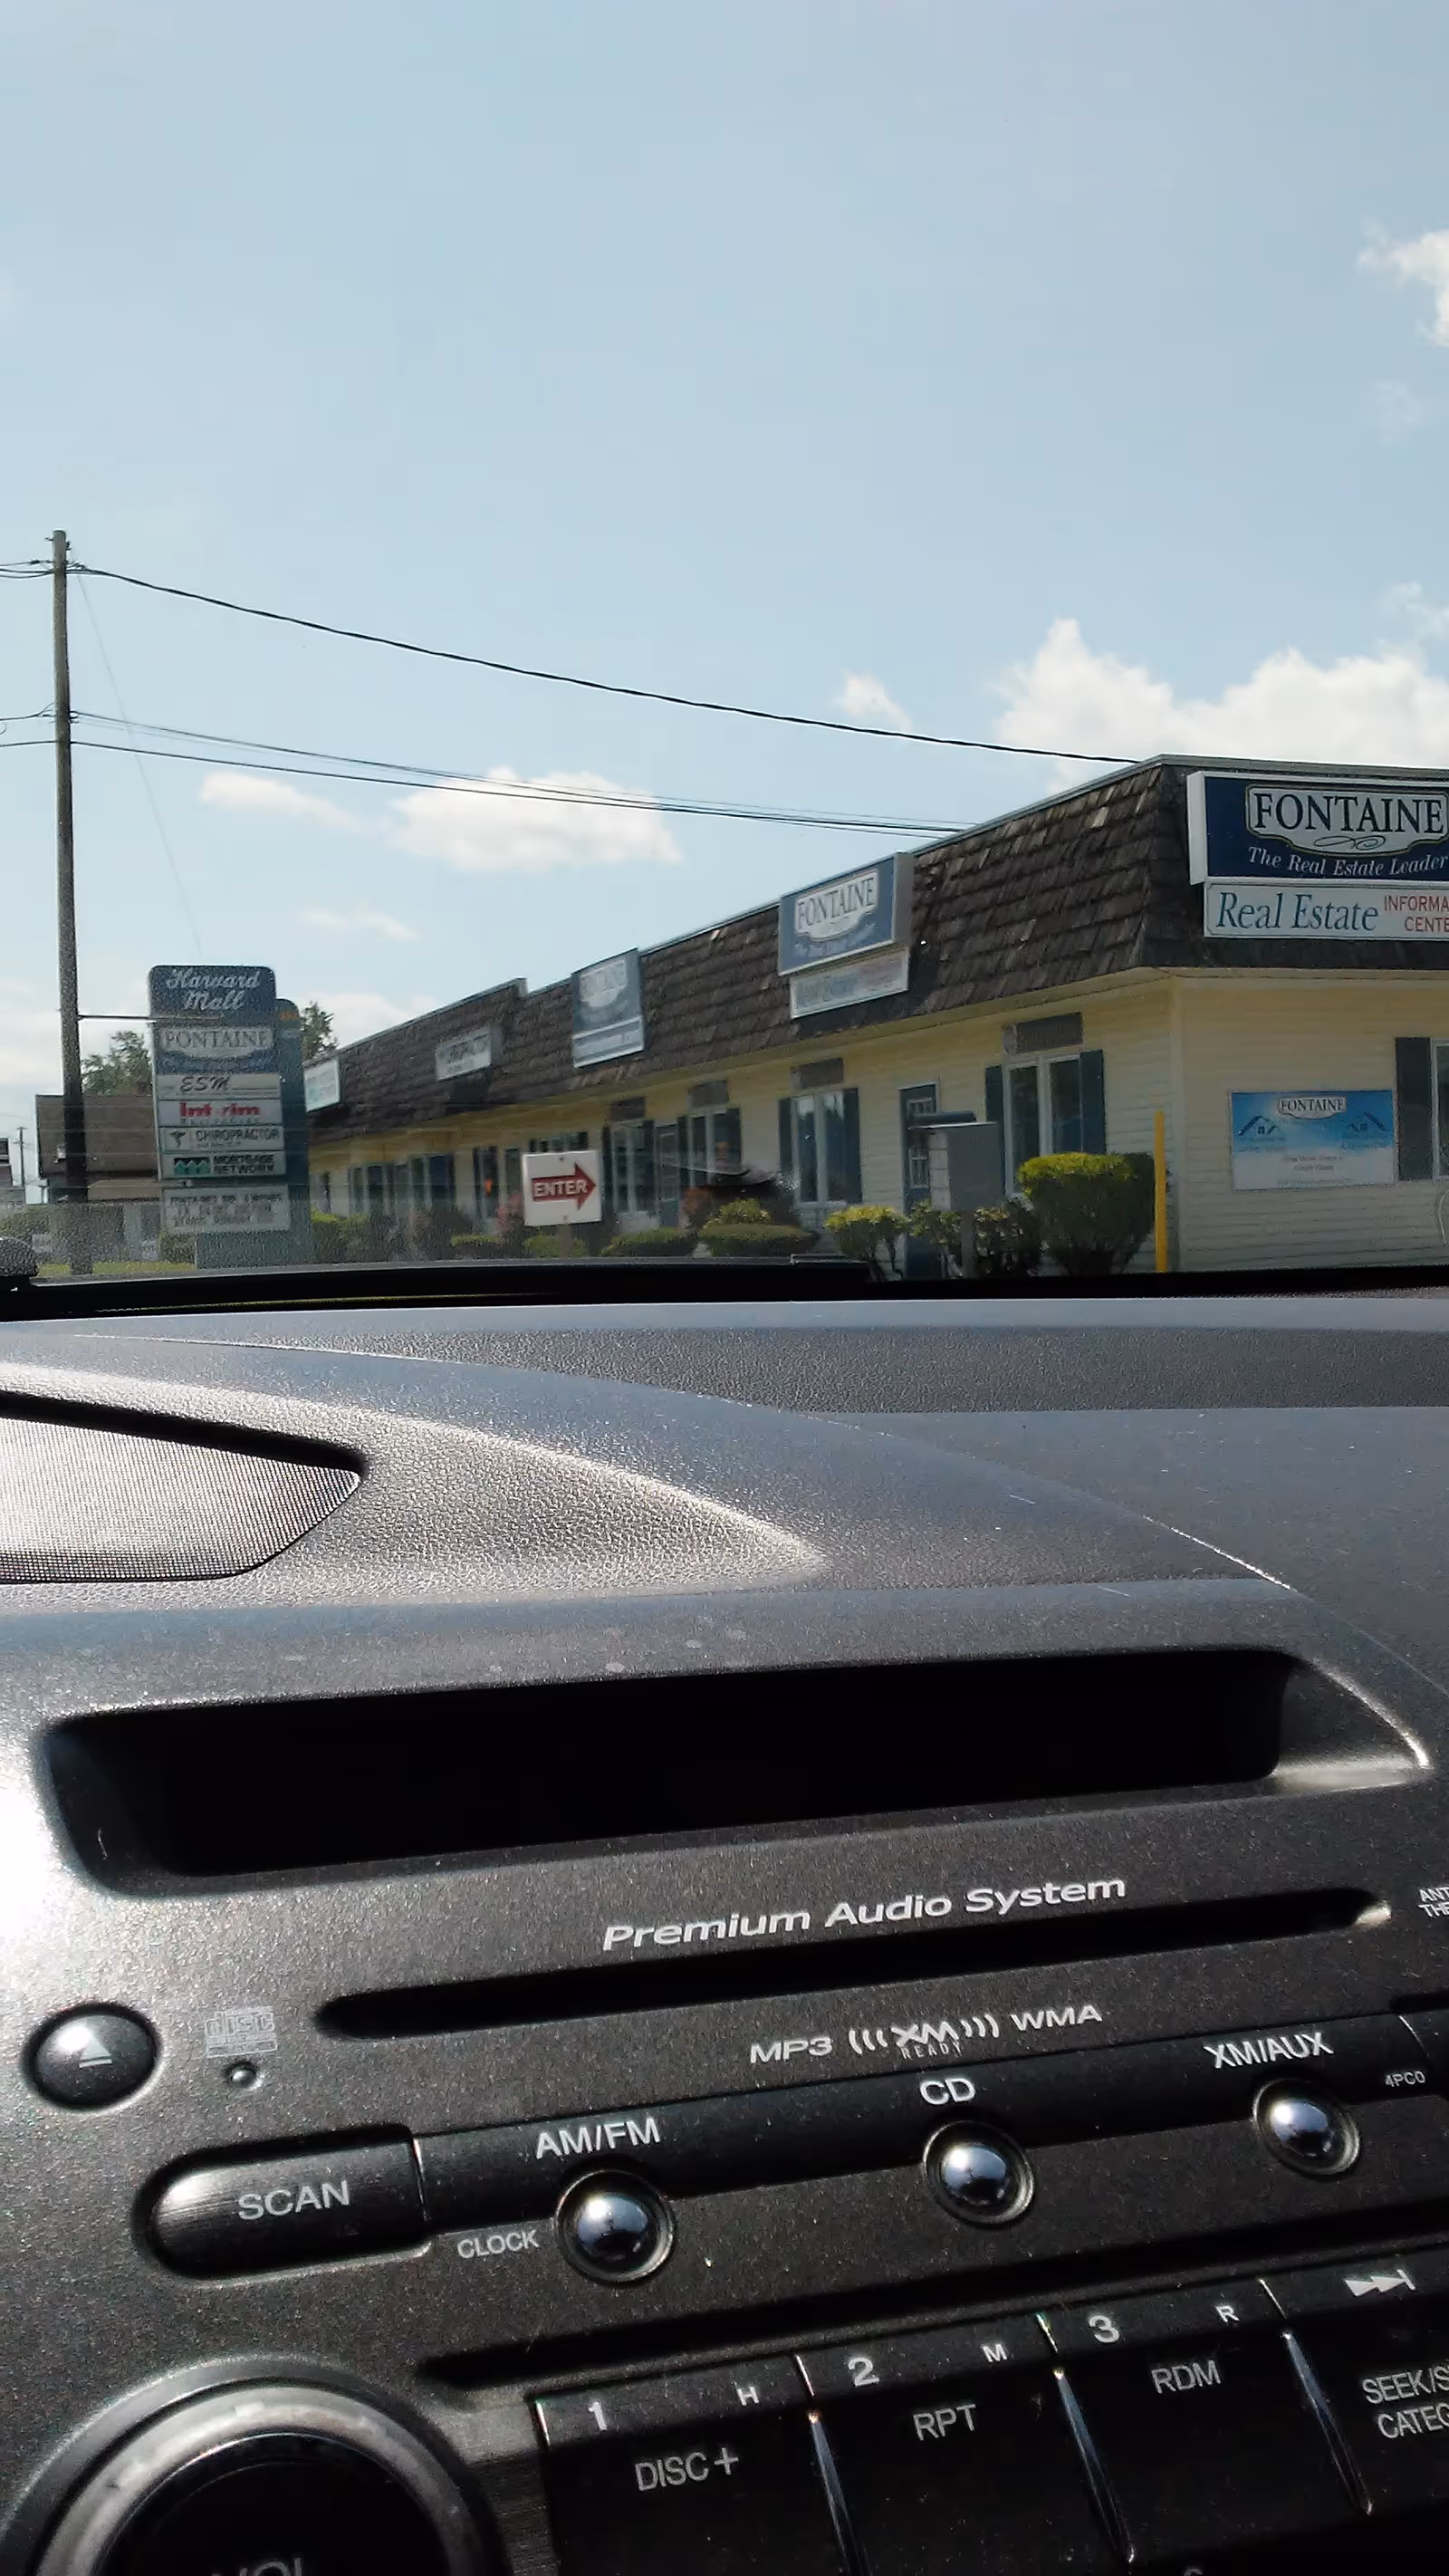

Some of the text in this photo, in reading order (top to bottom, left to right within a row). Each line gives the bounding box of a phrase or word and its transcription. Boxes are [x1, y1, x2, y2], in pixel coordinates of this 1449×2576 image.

[1253, 793, 1444, 833] FONTAINE
[1248, 846, 1281, 868] The
[1288, 854, 1326, 875] Real
[1333, 860, 1385, 877] Estate
[797, 877, 875, 929] FONTAINE
[1215, 891, 1283, 928] Real
[1290, 894, 1379, 932] Estate
[166, 969, 261, 989] Harvard
[183, 990, 245, 1011] Mall
[1281, 1098, 1344, 1111] FONTAINE
[196, 1129, 282, 1142] CHIROPRACTOR
[534, 1180, 587, 1197] ENTER
[602, 1878, 1126, 1951] Premium Audio System
[749, 2034, 834, 2064] MP3
[1010, 2004, 1103, 2032] WMA
[900, 2039, 964, 2060] READY
[1203, 2032, 1334, 2069] XM/AUX
[919, 2078, 975, 2106] CD
[535, 2118, 661, 2159] AM/FM
[237, 2180, 350, 2221] SCAN
[456, 2229, 541, 2259] CLOCK
[1215, 2304, 1240, 2322] R
[1088, 2315, 1120, 2344] 3
[982, 2343, 1008, 2363] M
[847, 2357, 880, 2388] 2
[1151, 2360, 1222, 2395] RDM
[589, 2401, 609, 2431] 1
[913, 2404, 976, 2441] RPT
